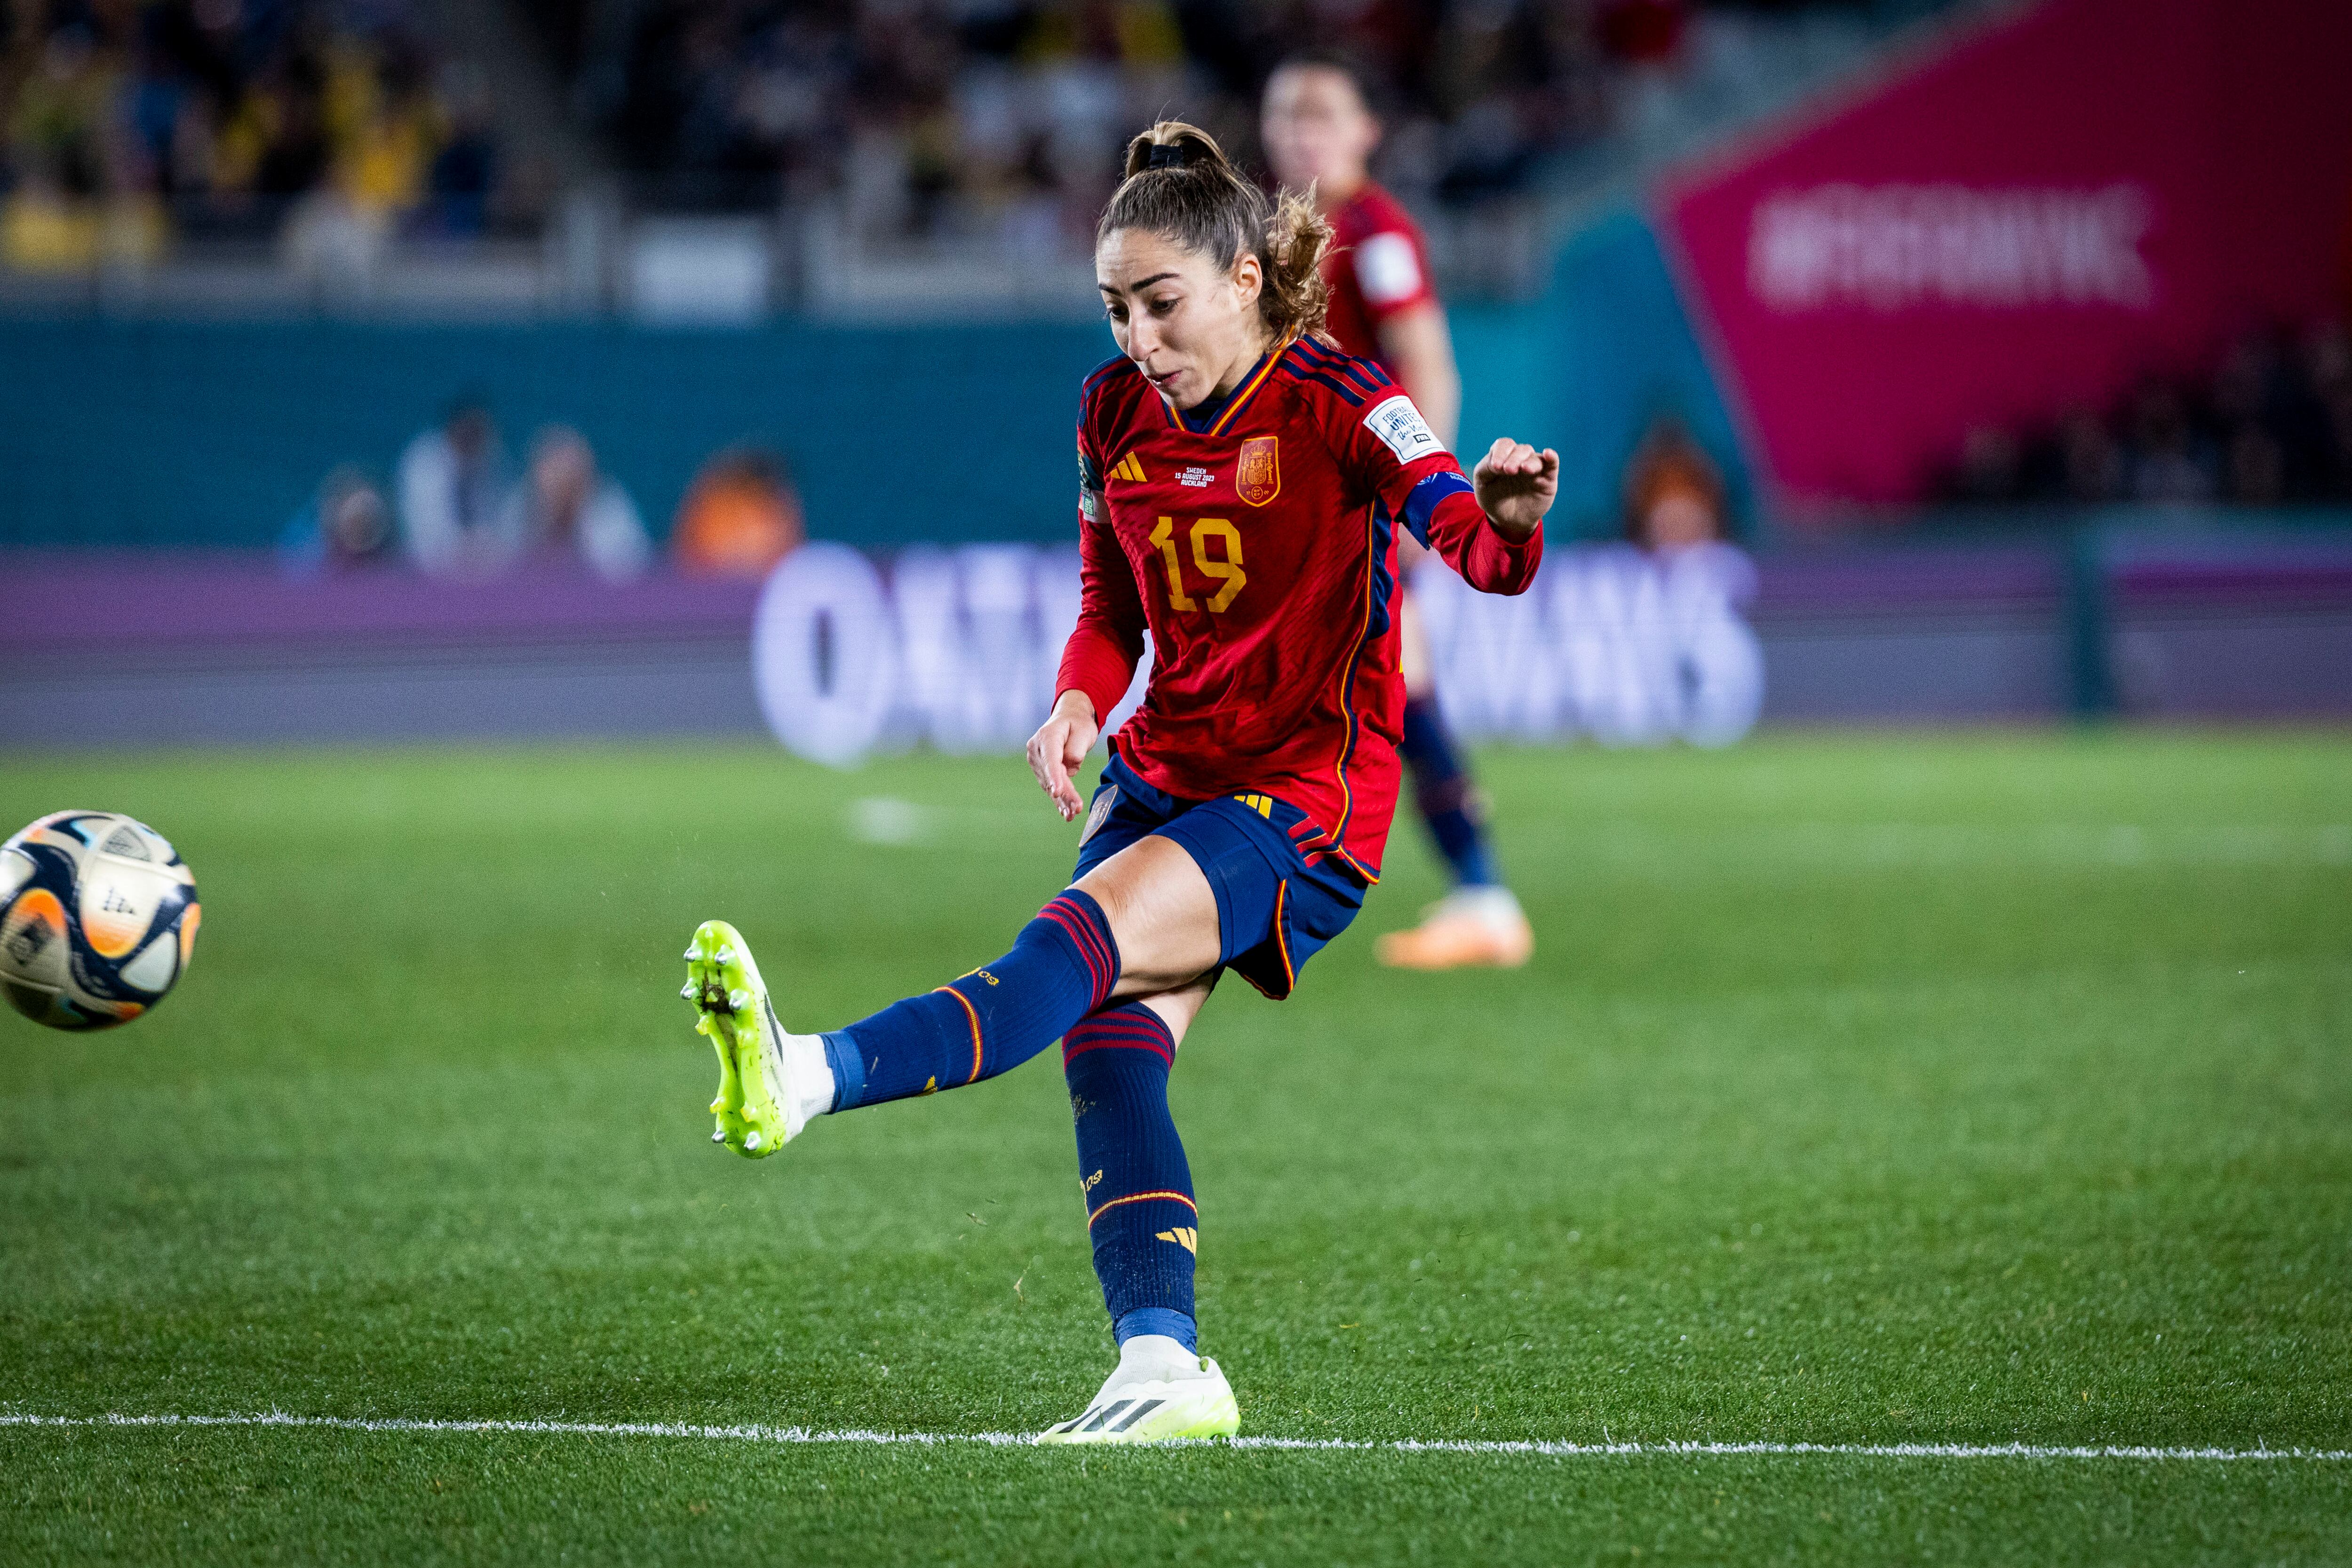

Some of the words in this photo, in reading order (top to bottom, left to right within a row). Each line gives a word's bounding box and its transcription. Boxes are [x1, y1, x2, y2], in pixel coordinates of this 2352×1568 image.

[1397, 430, 1411, 440] the
[1181, 479, 1207, 488] AUCKLAND
[1148, 516, 1247, 613] 19
